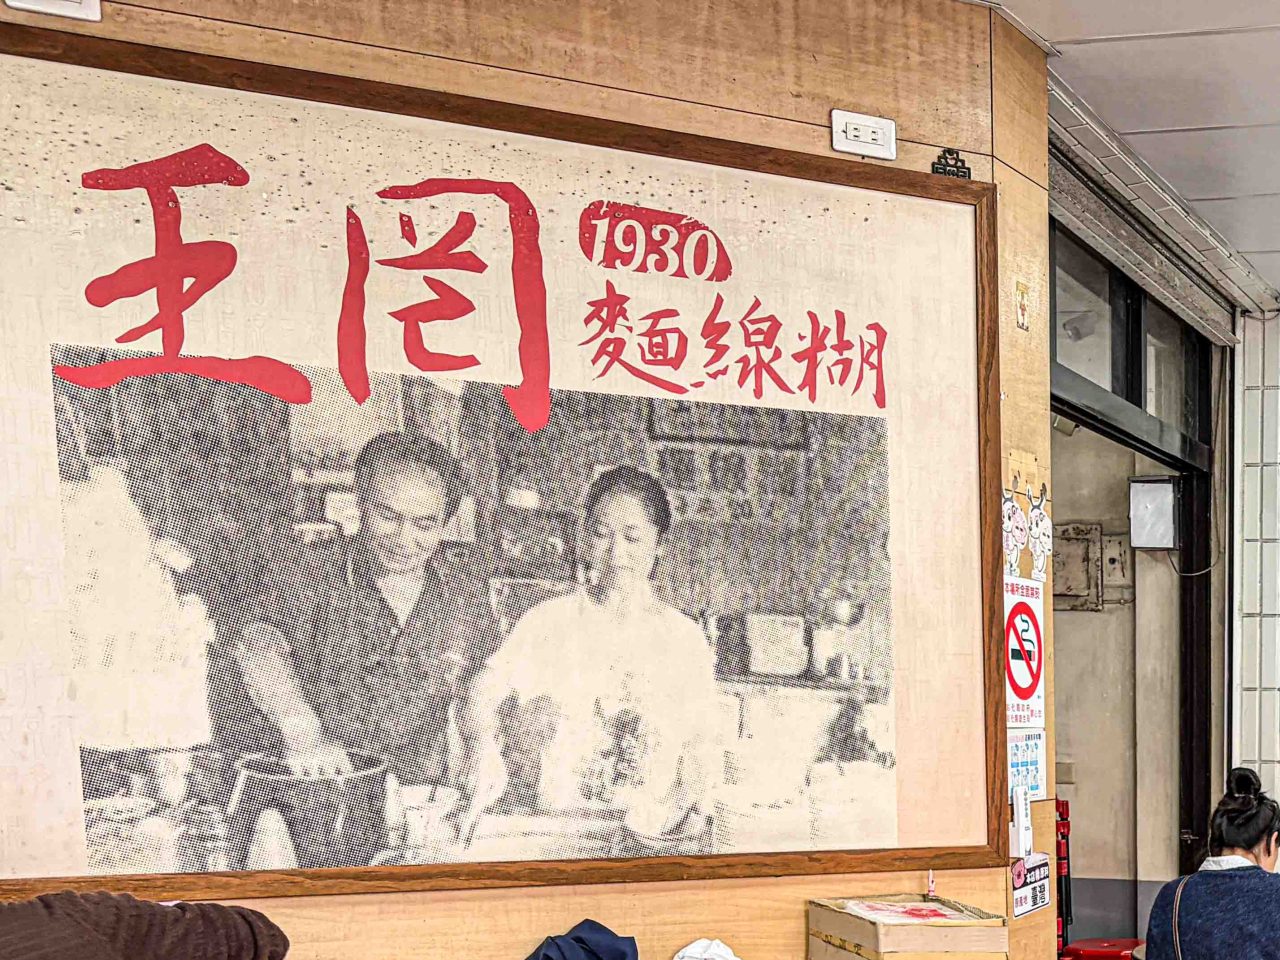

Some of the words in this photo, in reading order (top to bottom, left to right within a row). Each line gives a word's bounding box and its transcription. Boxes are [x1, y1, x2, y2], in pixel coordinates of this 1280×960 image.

[53, 143, 551, 434] 王罔
[590, 218, 719, 281] 1930
[577, 279, 888, 409] 麵線糊
